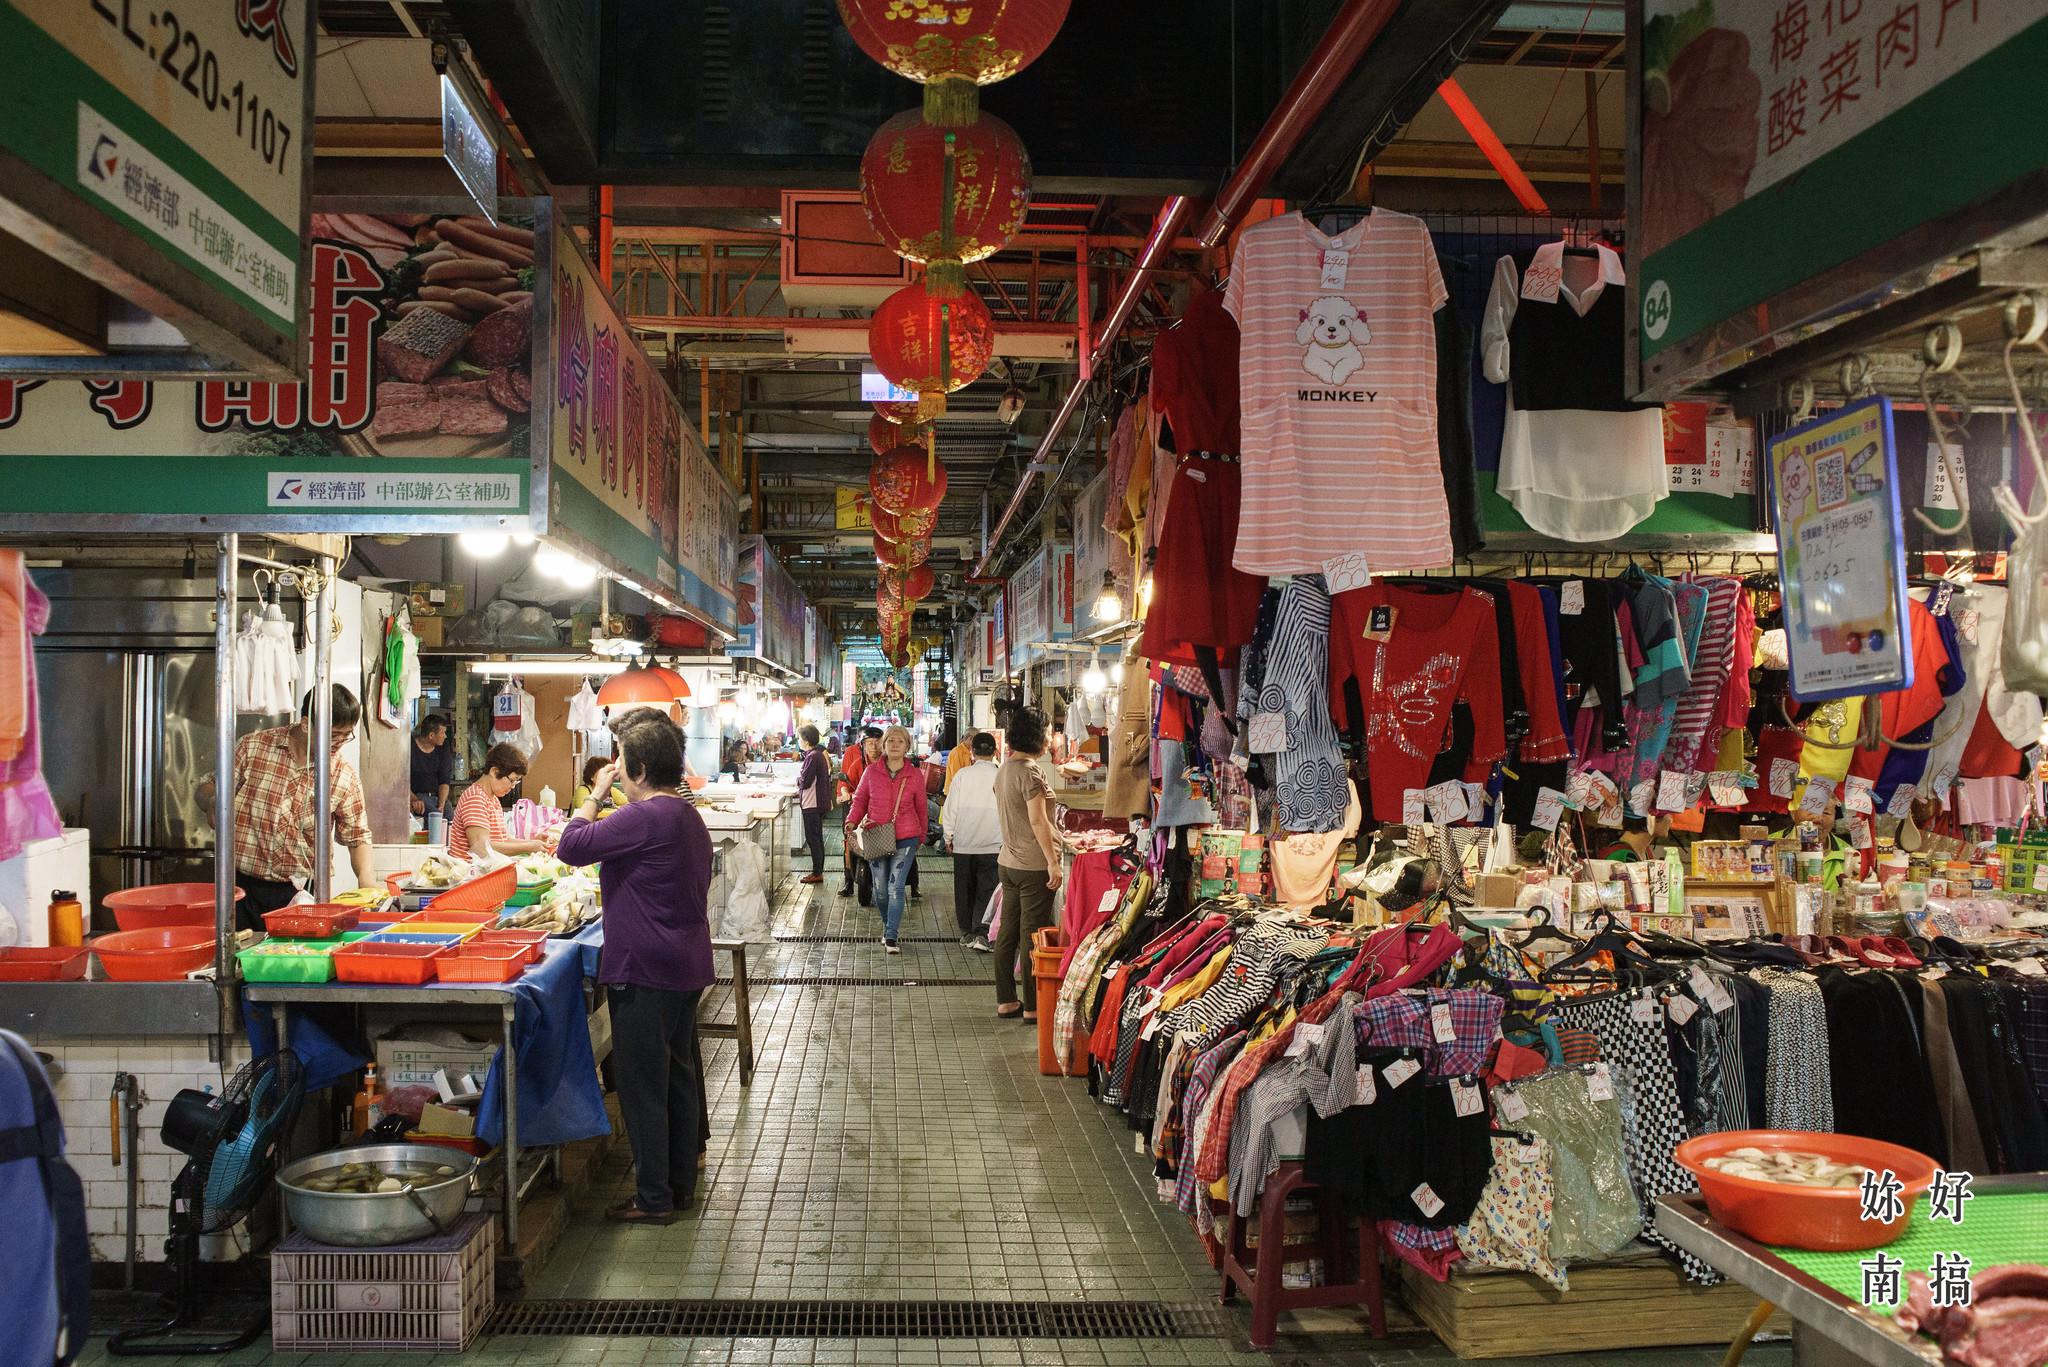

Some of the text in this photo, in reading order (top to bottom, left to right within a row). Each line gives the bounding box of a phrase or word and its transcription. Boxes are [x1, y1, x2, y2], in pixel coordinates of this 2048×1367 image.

[124, 158, 289, 306] 經濟部 中部辦公室補助
[1524, 279, 1559, 297] 690
[1647, 290, 1669, 328] 84
[899, 311, 926, 364] 吉祥
[1298, 390, 1378, 403] MONKEY
[1673, 467, 1702, 476] 23 24
[308, 481, 511, 502] 經濟部 中部辦公室補助
[1331, 567, 1367, 592] 100
[500, 696, 513, 711] 21
[1250, 730, 1284, 753] 390
[1456, 1095, 1481, 1116] 100
